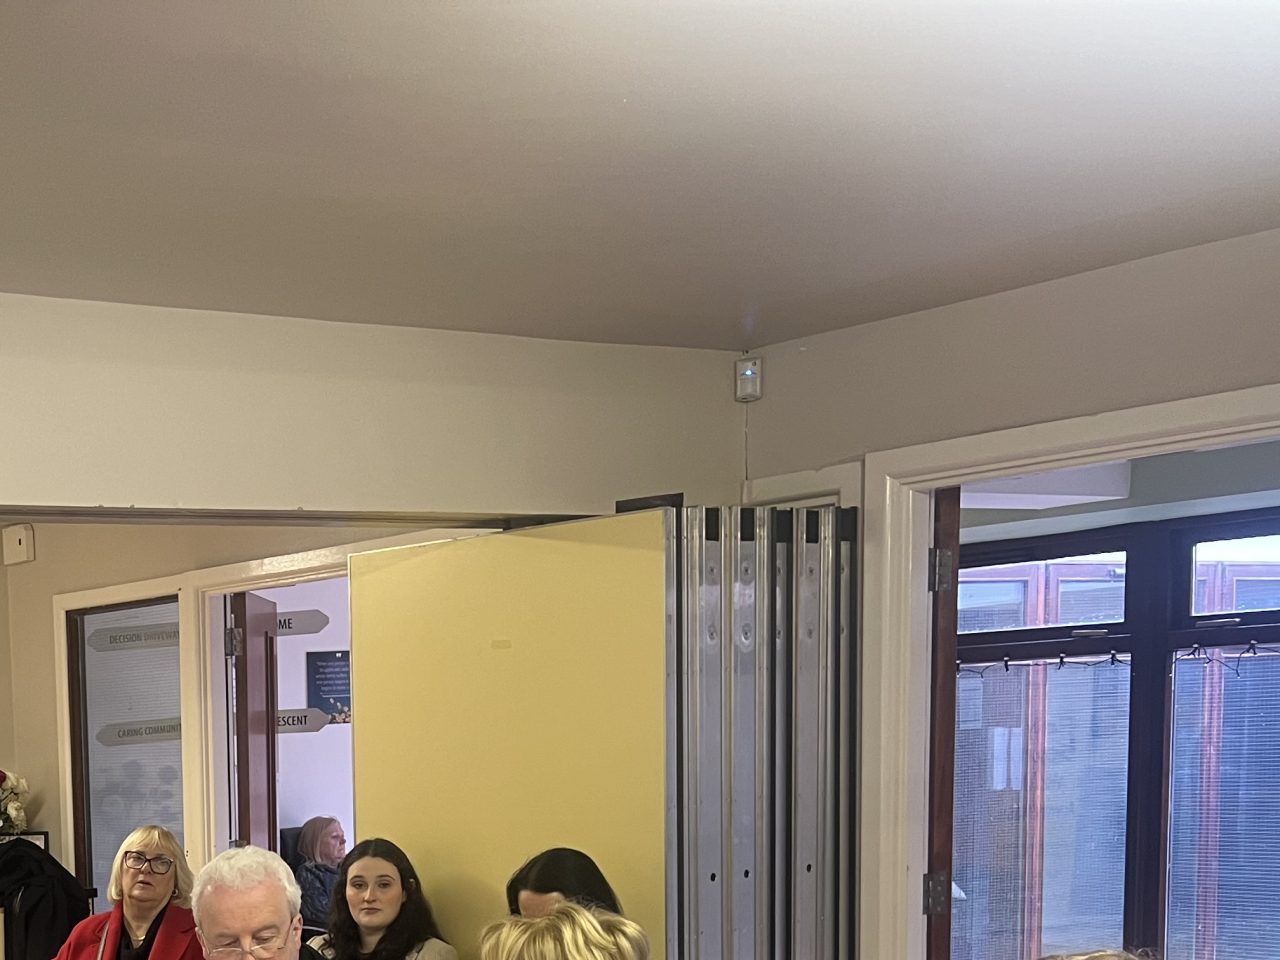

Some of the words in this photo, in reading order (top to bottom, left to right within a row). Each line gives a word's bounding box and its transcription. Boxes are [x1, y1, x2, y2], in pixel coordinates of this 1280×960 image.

[277, 618, 293, 630] ME
[109, 633, 142, 645] DECISION
[277, 715, 308, 727] ESCENT
[117, 727, 143, 739] CARING
